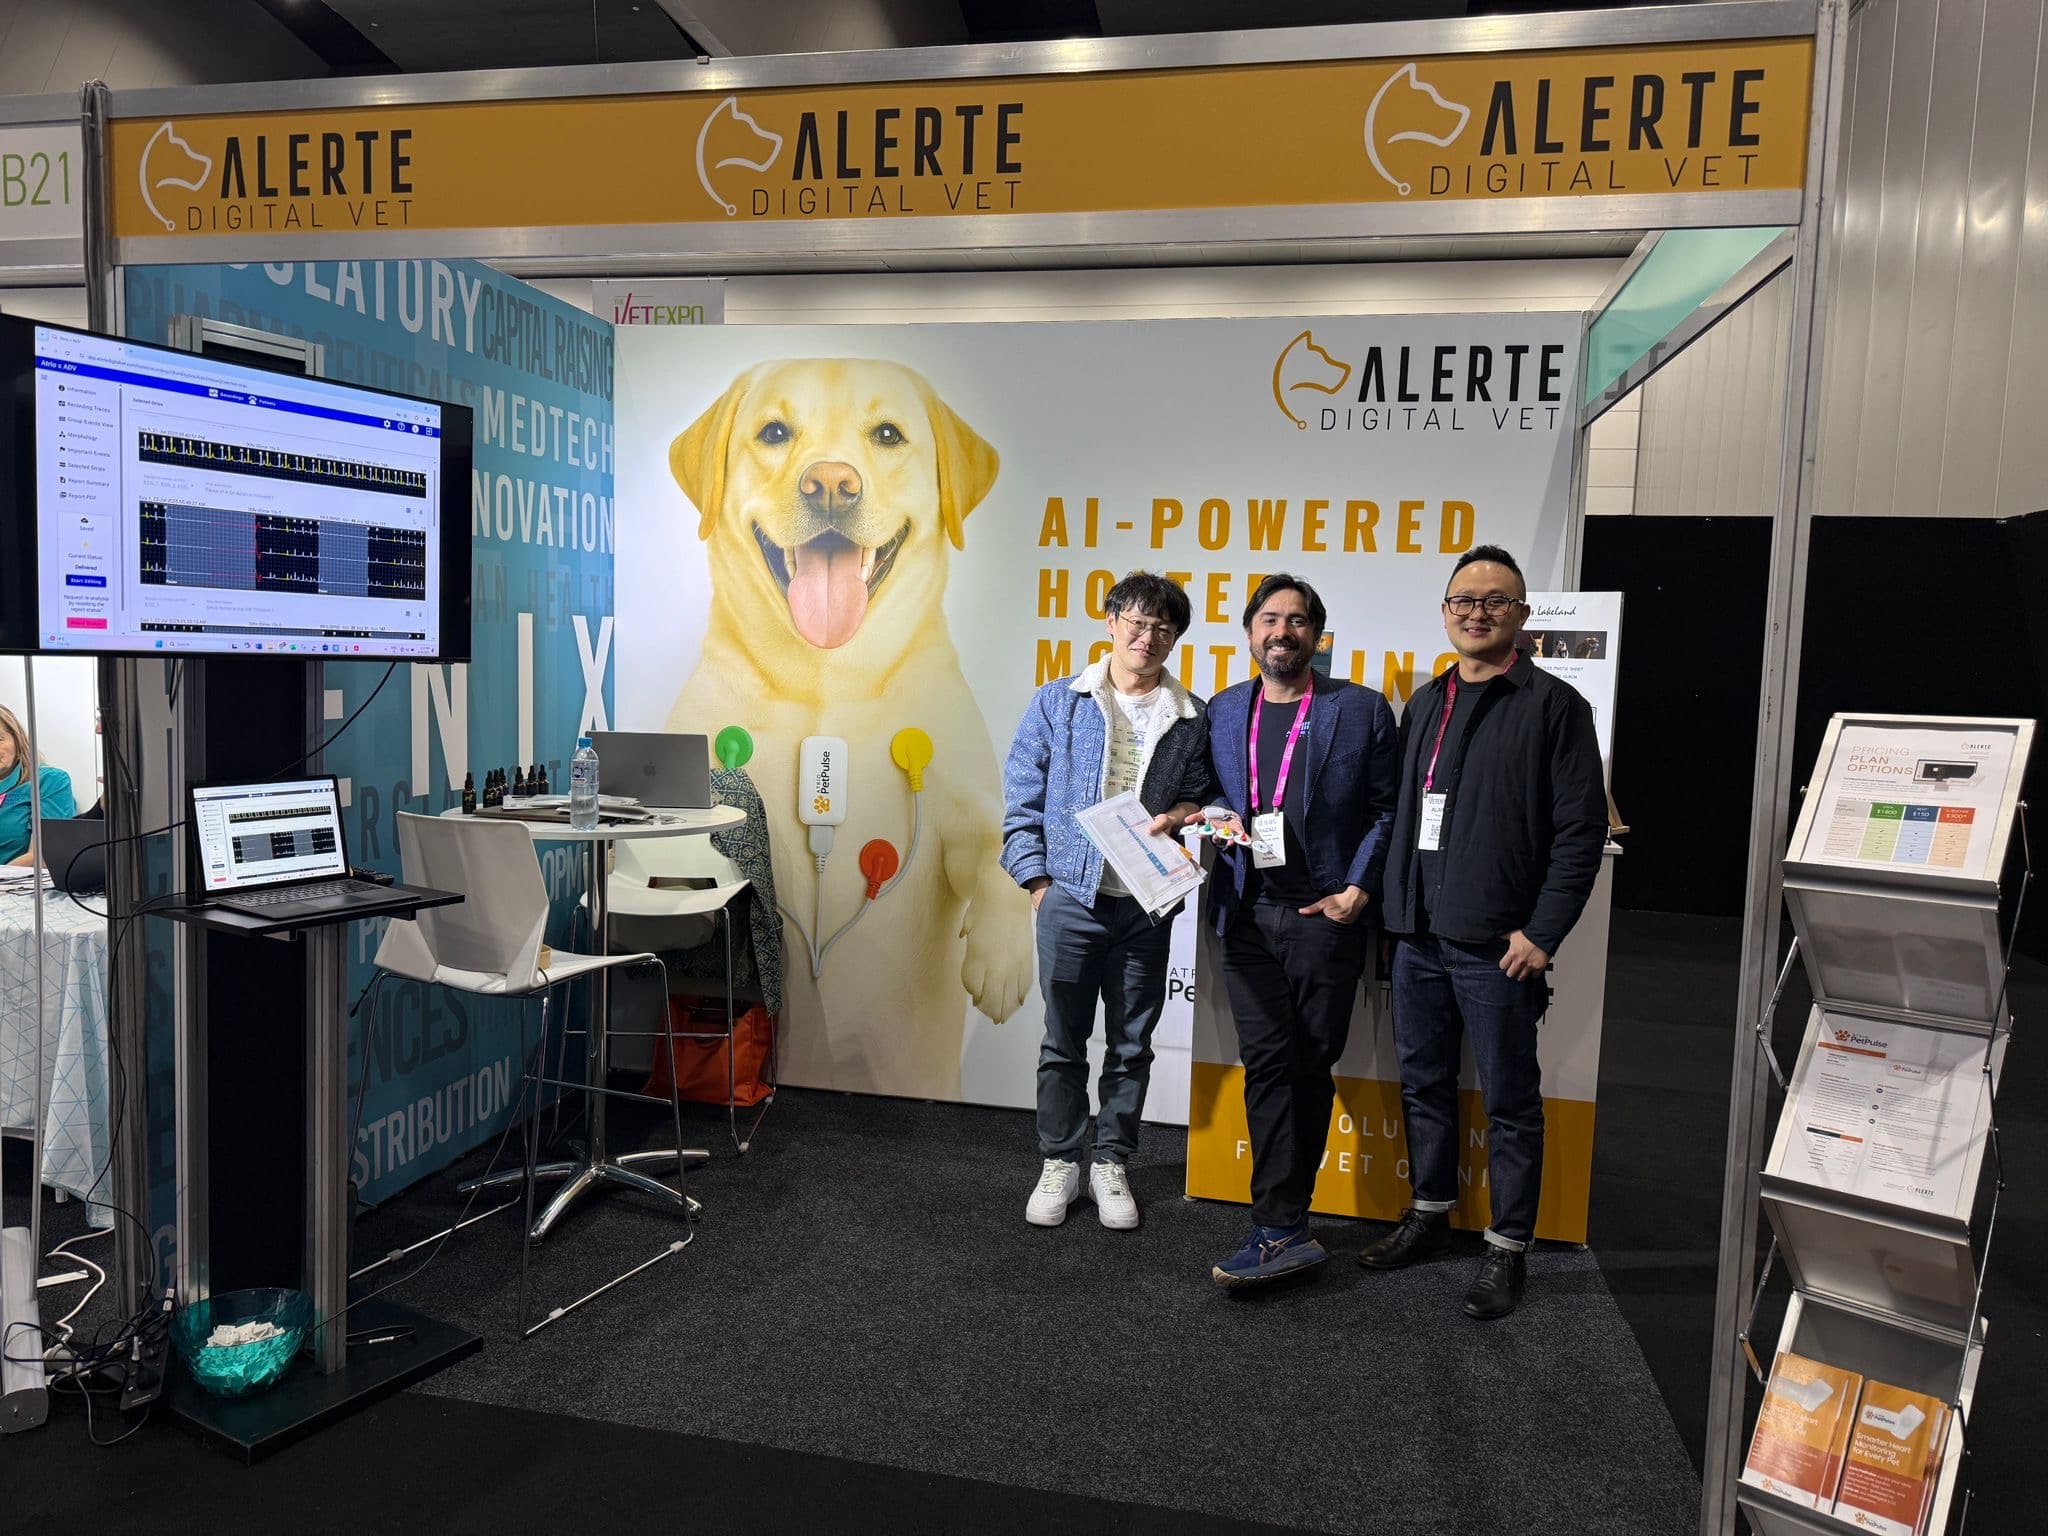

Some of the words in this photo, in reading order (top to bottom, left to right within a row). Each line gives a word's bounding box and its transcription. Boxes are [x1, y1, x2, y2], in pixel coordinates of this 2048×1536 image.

[1480, 69, 1765, 156] ALERTE
[792, 103, 1023, 180] ALERTE
[221, 129, 413, 199] ALERTE
[2, 151, 70, 207] B21
[1429, 160, 1625, 195] DIGITAL
[1664, 154, 1758, 187] VET
[753, 185, 913, 215] DIGITAL
[944, 181, 1021, 210] VET
[188, 203, 323, 231] DIGITAL
[349, 200, 412, 226] VET
[482, 283, 553, 380] CAPITAL
[41, 360, 56, 369] Atrio
[63, 363, 77, 372] ADV
[1358, 344, 1564, 402] ALERTE
[67, 386, 97, 396] Information
[67, 401, 92, 411] Recording
[94, 405, 110, 413] Traces
[67, 416, 83, 426] Group
[84, 419, 100, 427] Events
[1321, 408, 1464, 430] DIGITAL
[1492, 407, 1560, 430] VET
[67, 432, 98, 442] Morphology
[483, 384, 615, 476] MEDTECH
[67, 446, 92, 457] Important
[68, 462, 90, 471] Selected
[91, 465, 105, 473] Strips
[68, 477, 84, 486] Report
[86, 480, 110, 489] Summary
[68, 492, 84, 501] Report
[1038, 497, 1475, 553] AI-POWERED
[1038, 569, 1275, 623] HOTE
[1537, 605, 1577, 616] Lakeland
[1035, 639, 1460, 702] MOITING
[1849, 755, 1890, 765] PLAN
[1852, 745, 1910, 756] PRICING
[820, 751, 831, 794] PetPulse
[1847, 764, 1914, 776] OPTIONS
[1850, 1035, 1888, 1049] PetPulse
[1854, 1439, 1897, 1459] Monitoring
[1855, 1432, 1889, 1446] Smarter
[1889, 1441, 1912, 1454] Heart
[1864, 1450, 1887, 1463] Every
[1887, 1457, 1900, 1467] Pet
[1866, 1517, 1888, 1532] PetPulse
